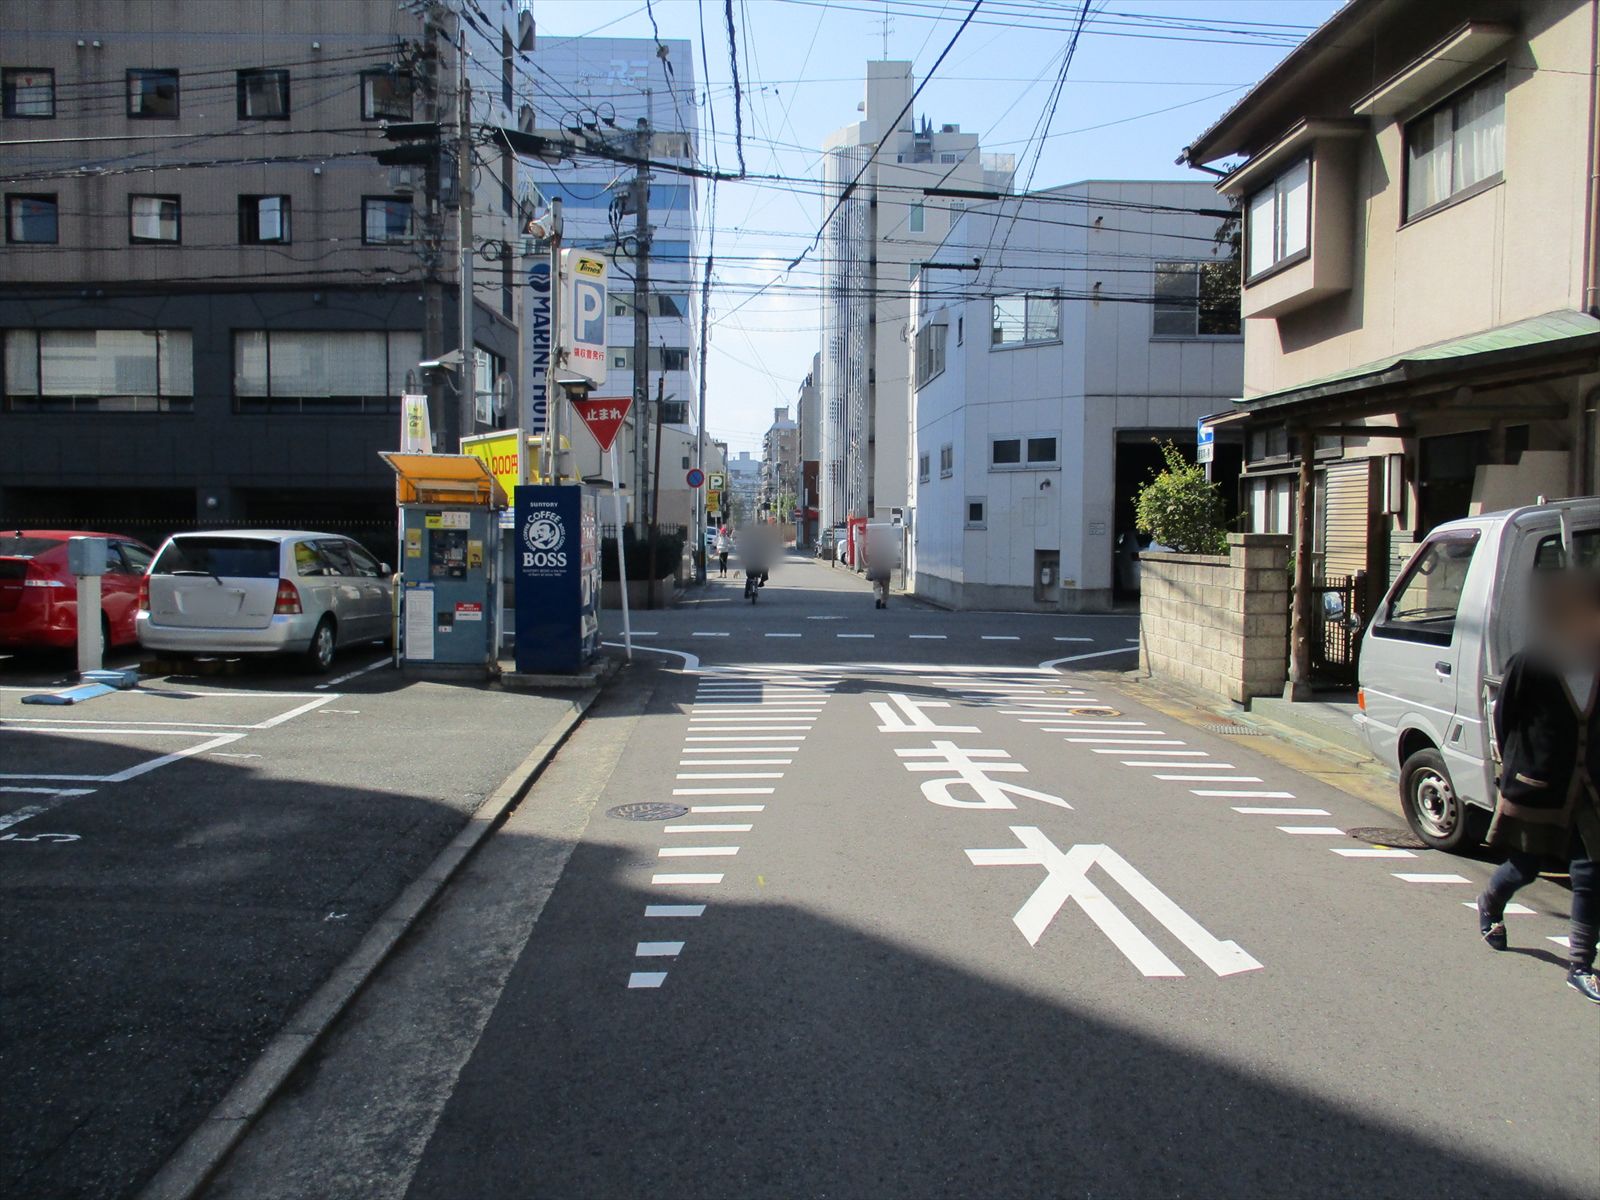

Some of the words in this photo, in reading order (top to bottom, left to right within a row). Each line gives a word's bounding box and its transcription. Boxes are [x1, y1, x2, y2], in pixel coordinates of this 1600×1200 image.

[580, 260, 603, 274] Times
[577, 283, 602, 340] P
[533, 297, 551, 378] MARINE
[586, 407, 622, 421] 止まれ
[711, 476, 723, 489] P
[528, 511, 561, 523] COFFEE
[523, 553, 567, 567] BOSS
[869, 693, 1264, 977] 止まれ
